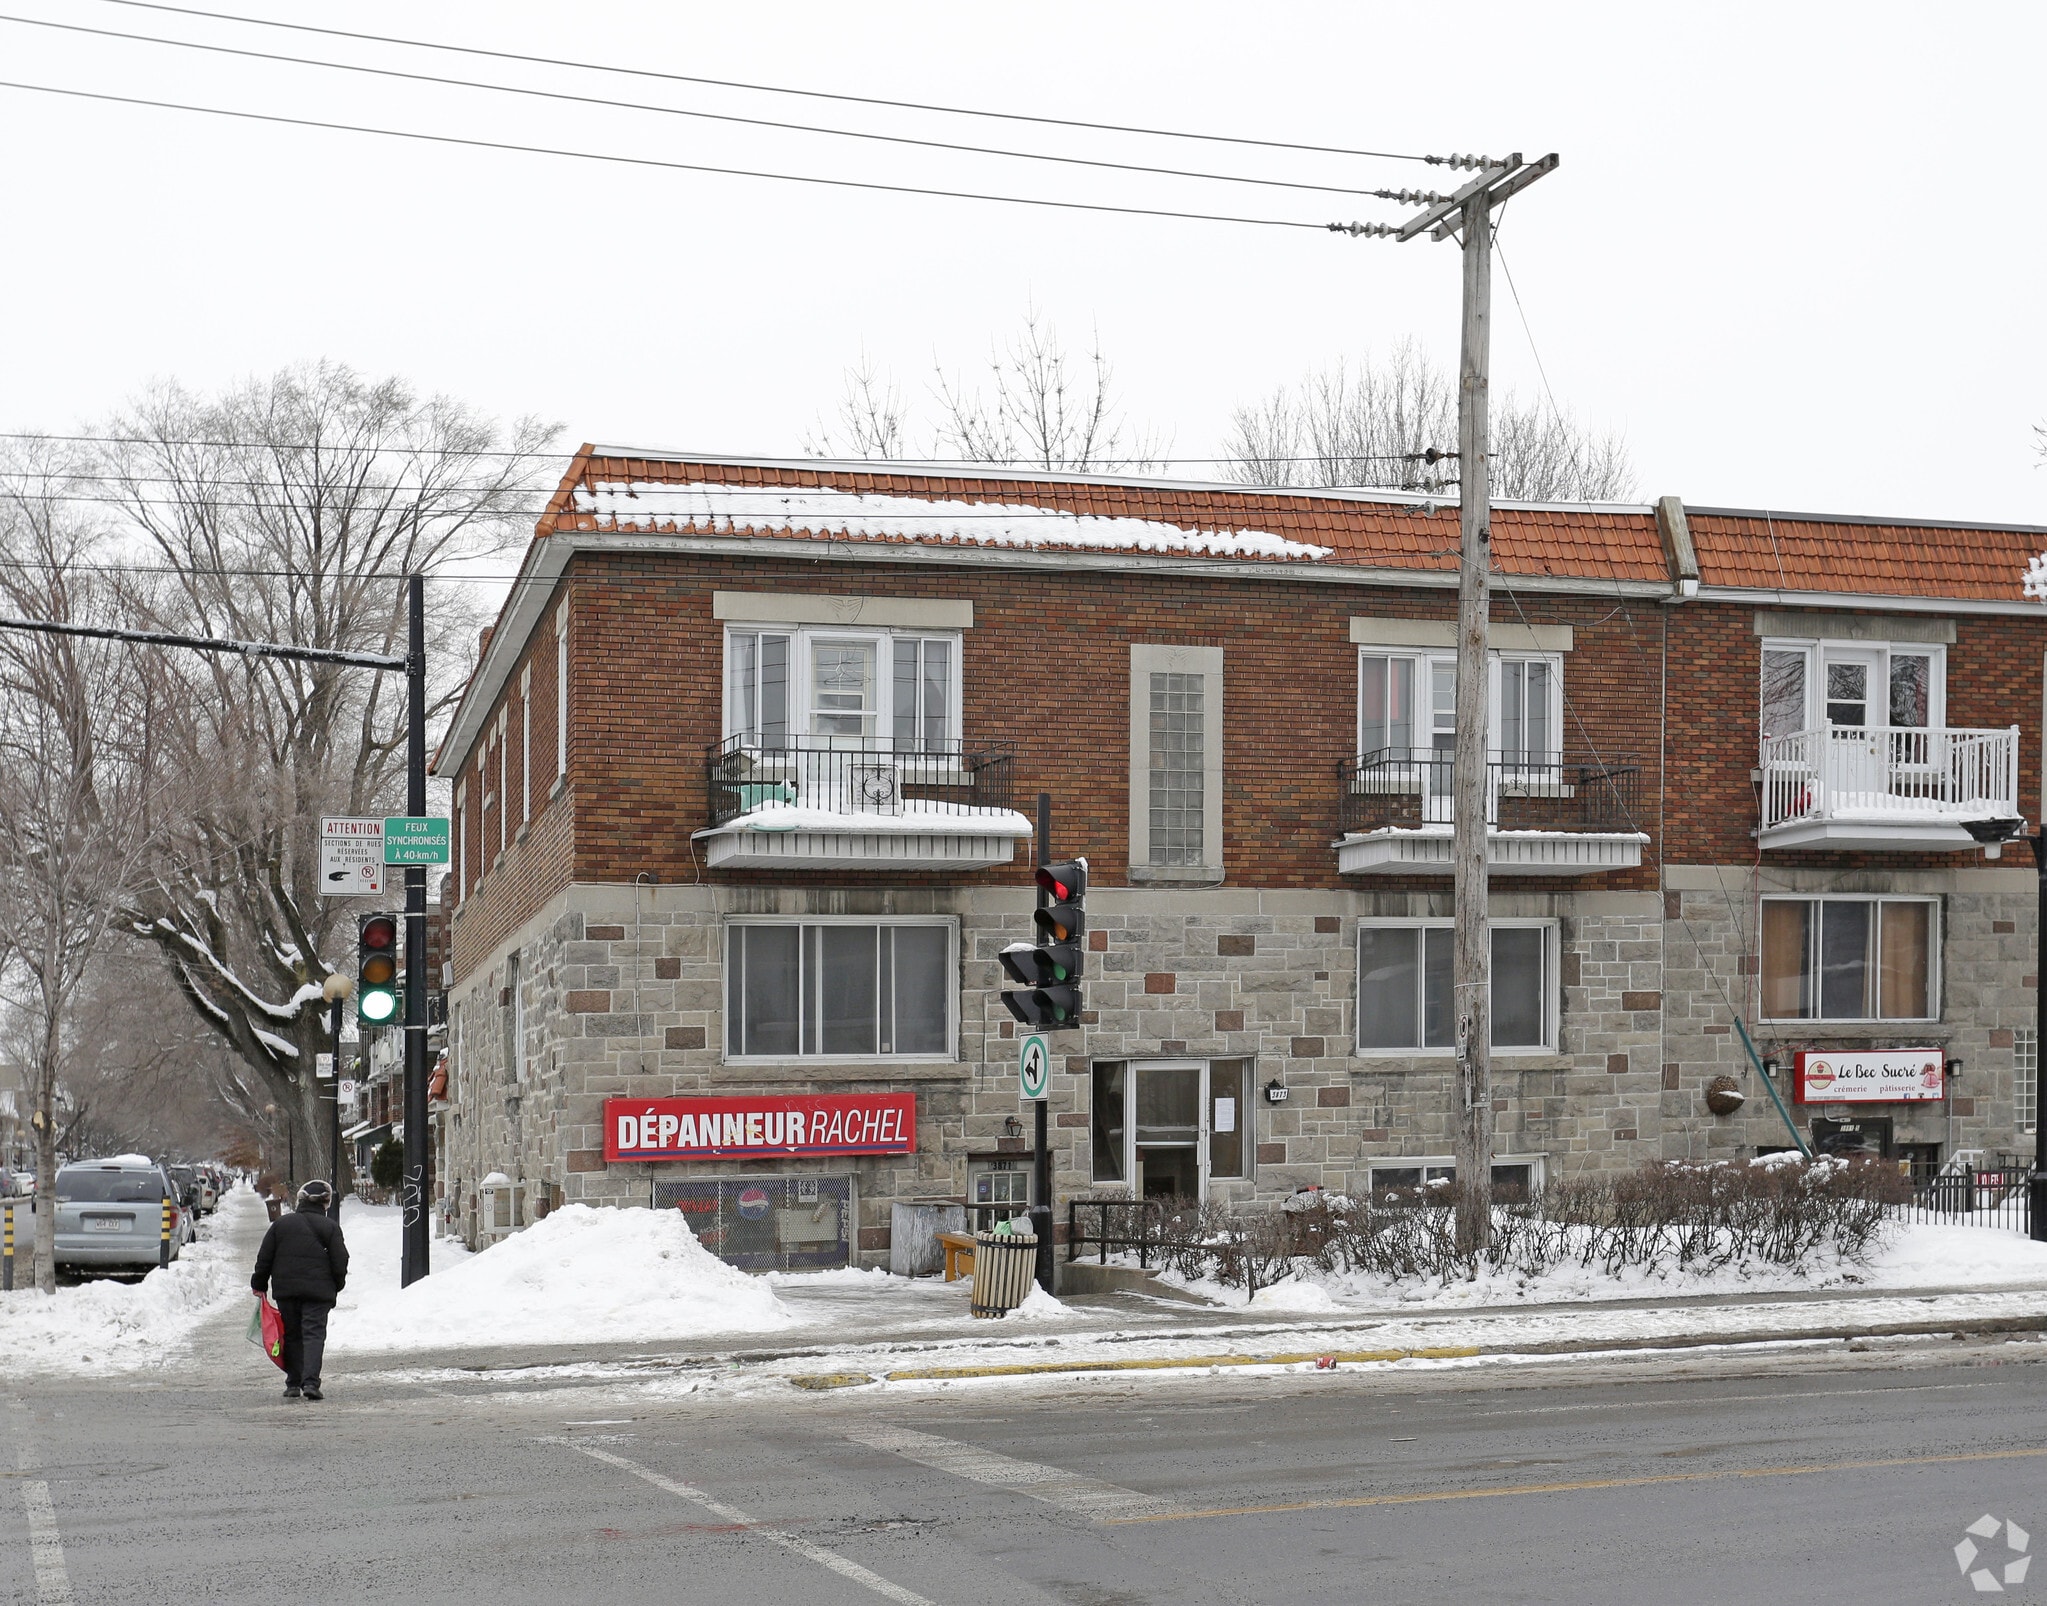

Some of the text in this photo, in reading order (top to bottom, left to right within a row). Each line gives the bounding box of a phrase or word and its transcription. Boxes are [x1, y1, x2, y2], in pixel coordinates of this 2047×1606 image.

[327, 822, 380, 835] ATTENTION
[405, 822, 428, 832] FEUX
[367, 840, 382, 848] RUES
[386, 833, 447, 846] SYNCHRONISÉS
[394, 847, 439, 860] À 40 km/h
[1838, 1063, 1917, 1079] Le Bec Sucré
[1879, 1084, 1916, 1095] pâtisserie
[617, 1108, 909, 1149] DÉPANNEUR RACHEL
